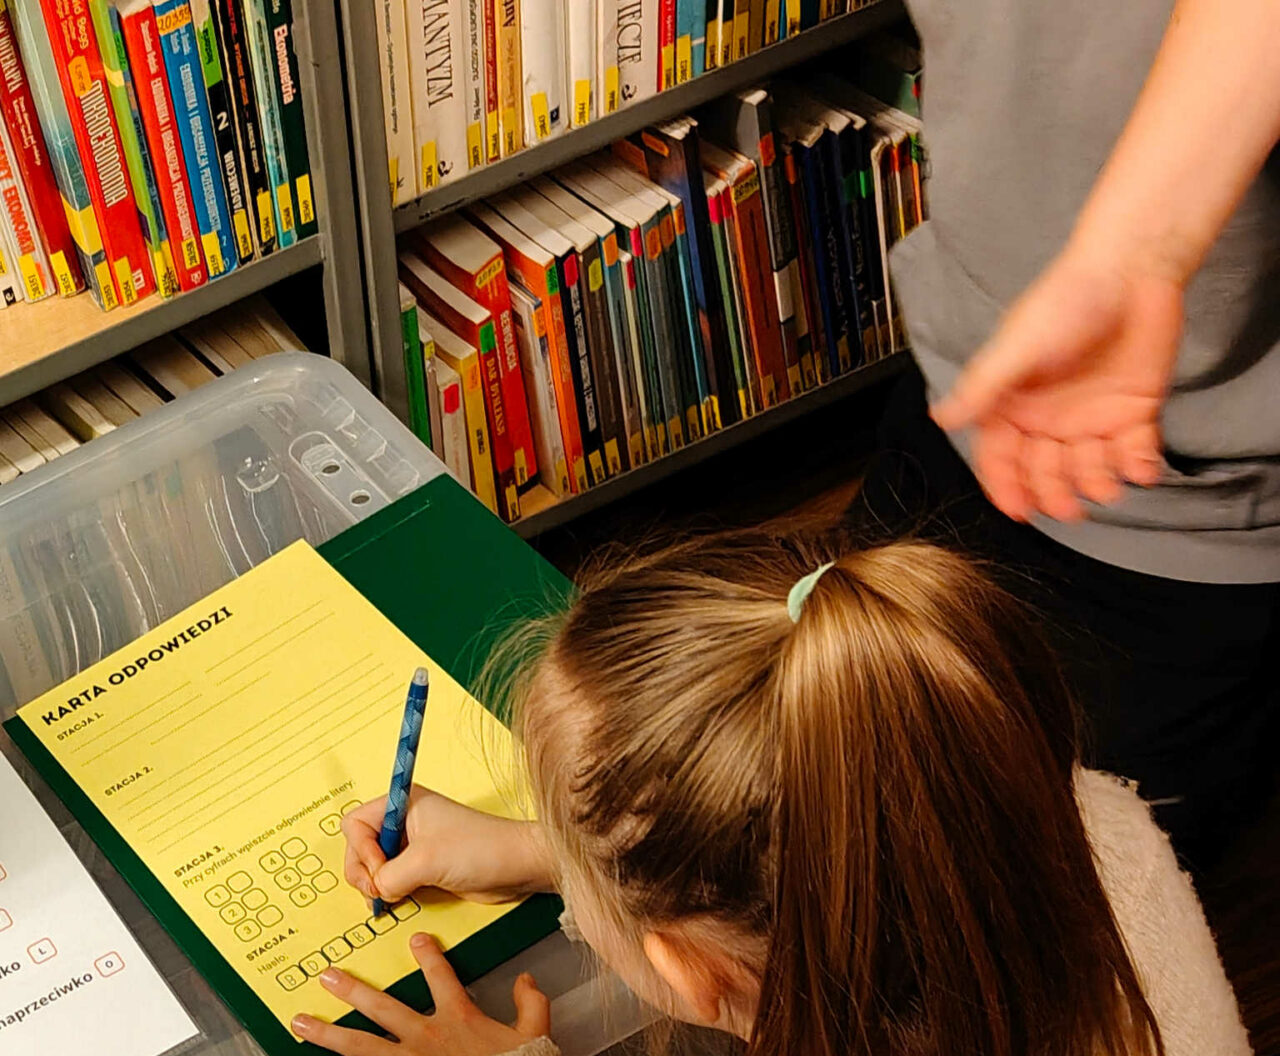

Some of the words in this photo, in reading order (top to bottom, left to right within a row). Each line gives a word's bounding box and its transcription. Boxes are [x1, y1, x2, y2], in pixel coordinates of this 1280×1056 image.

[74, 18, 90, 49] Begg
[180, 63, 199, 109] EKONOMIKA
[274, 26, 296, 105] Ekonometria
[151, 79, 170, 125] EKONOMIKA
[216, 112, 229, 131] 2
[79, 80, 128, 207] MIKROEKONOMIA
[2, 186, 36, 256] EKONOMII
[499, 309, 517, 373] REWOLUCJA
[41, 684, 107, 726] KARTA
[108, 605, 234, 686] ODPOWIEDZI
[56, 716, 96, 742] STACJA
[104, 771, 143, 797] STACJA
[182, 871, 205, 889] Przy
[204, 851, 238, 877] cyfrach
[238, 828, 276, 856] wpiszcie
[276, 793, 331, 831] odpowiednie
[328, 780, 357, 800] litery.
[173, 849, 214, 878] STACJA
[245, 933, 287, 962] STACJA
